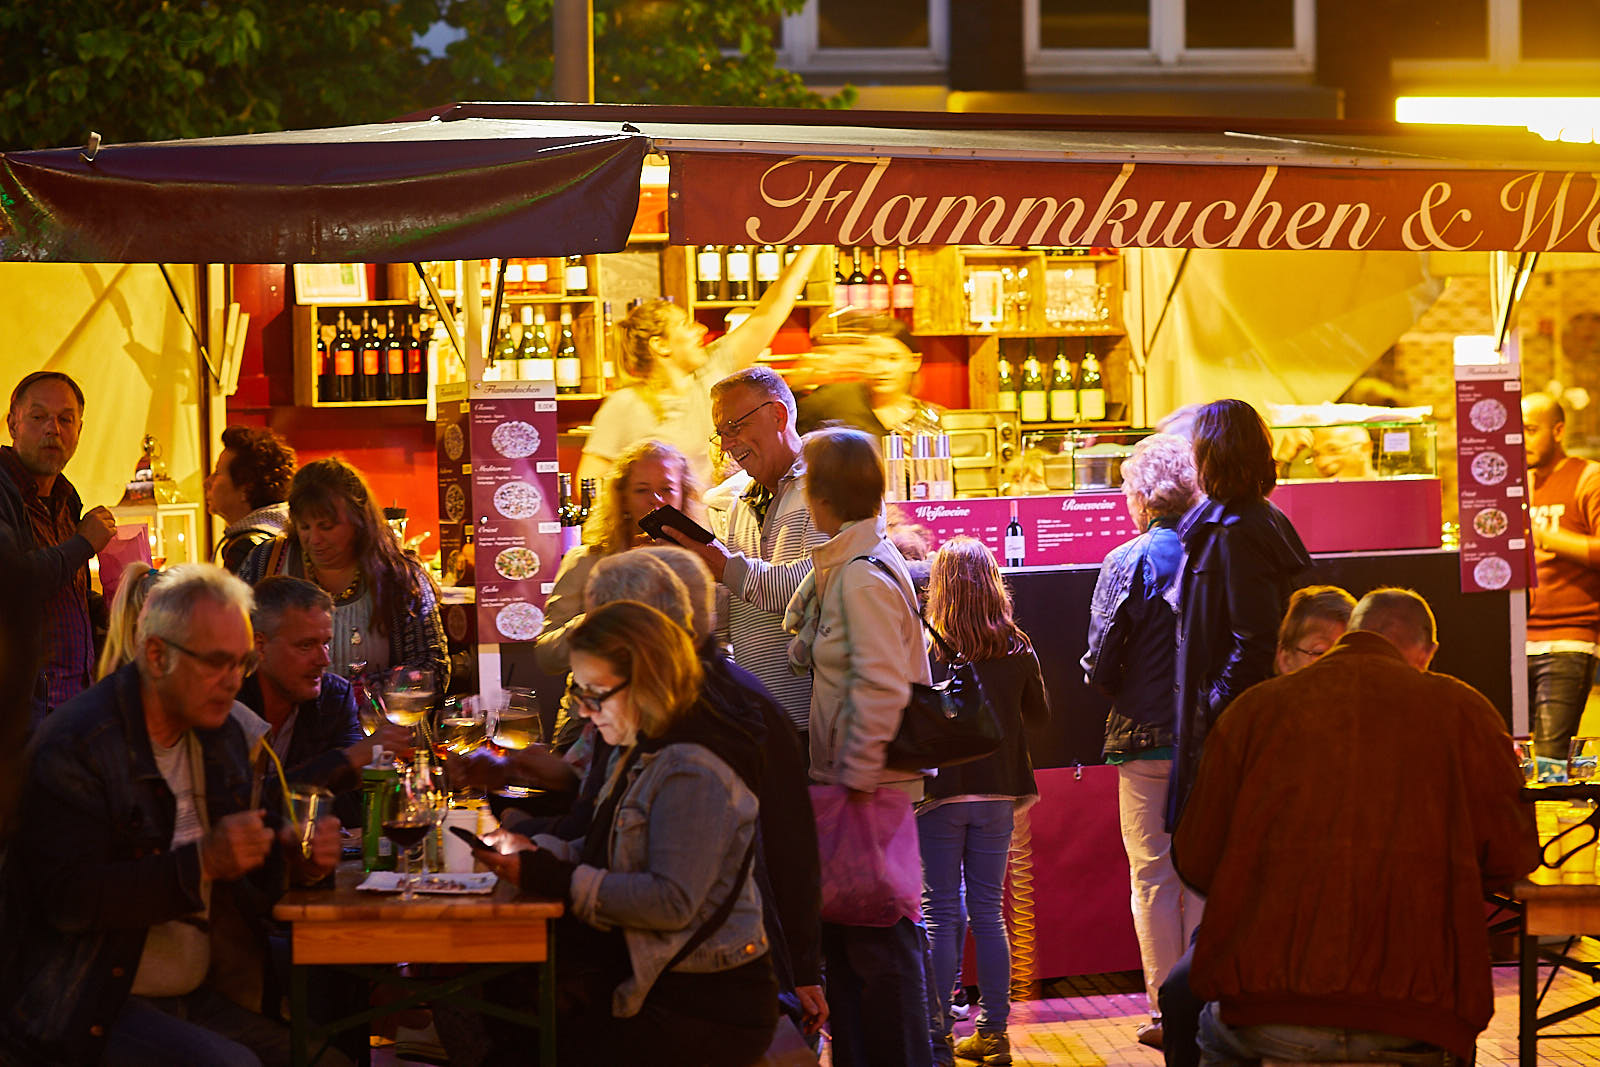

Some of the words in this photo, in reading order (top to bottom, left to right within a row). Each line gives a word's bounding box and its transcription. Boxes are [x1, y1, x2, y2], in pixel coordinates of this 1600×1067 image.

[745, 155, 1386, 250] Flammkuchen
[1401, 181, 1484, 252] &
[483, 384, 541, 394] Flammkuchen
[915, 505, 971, 521] Weißweine
